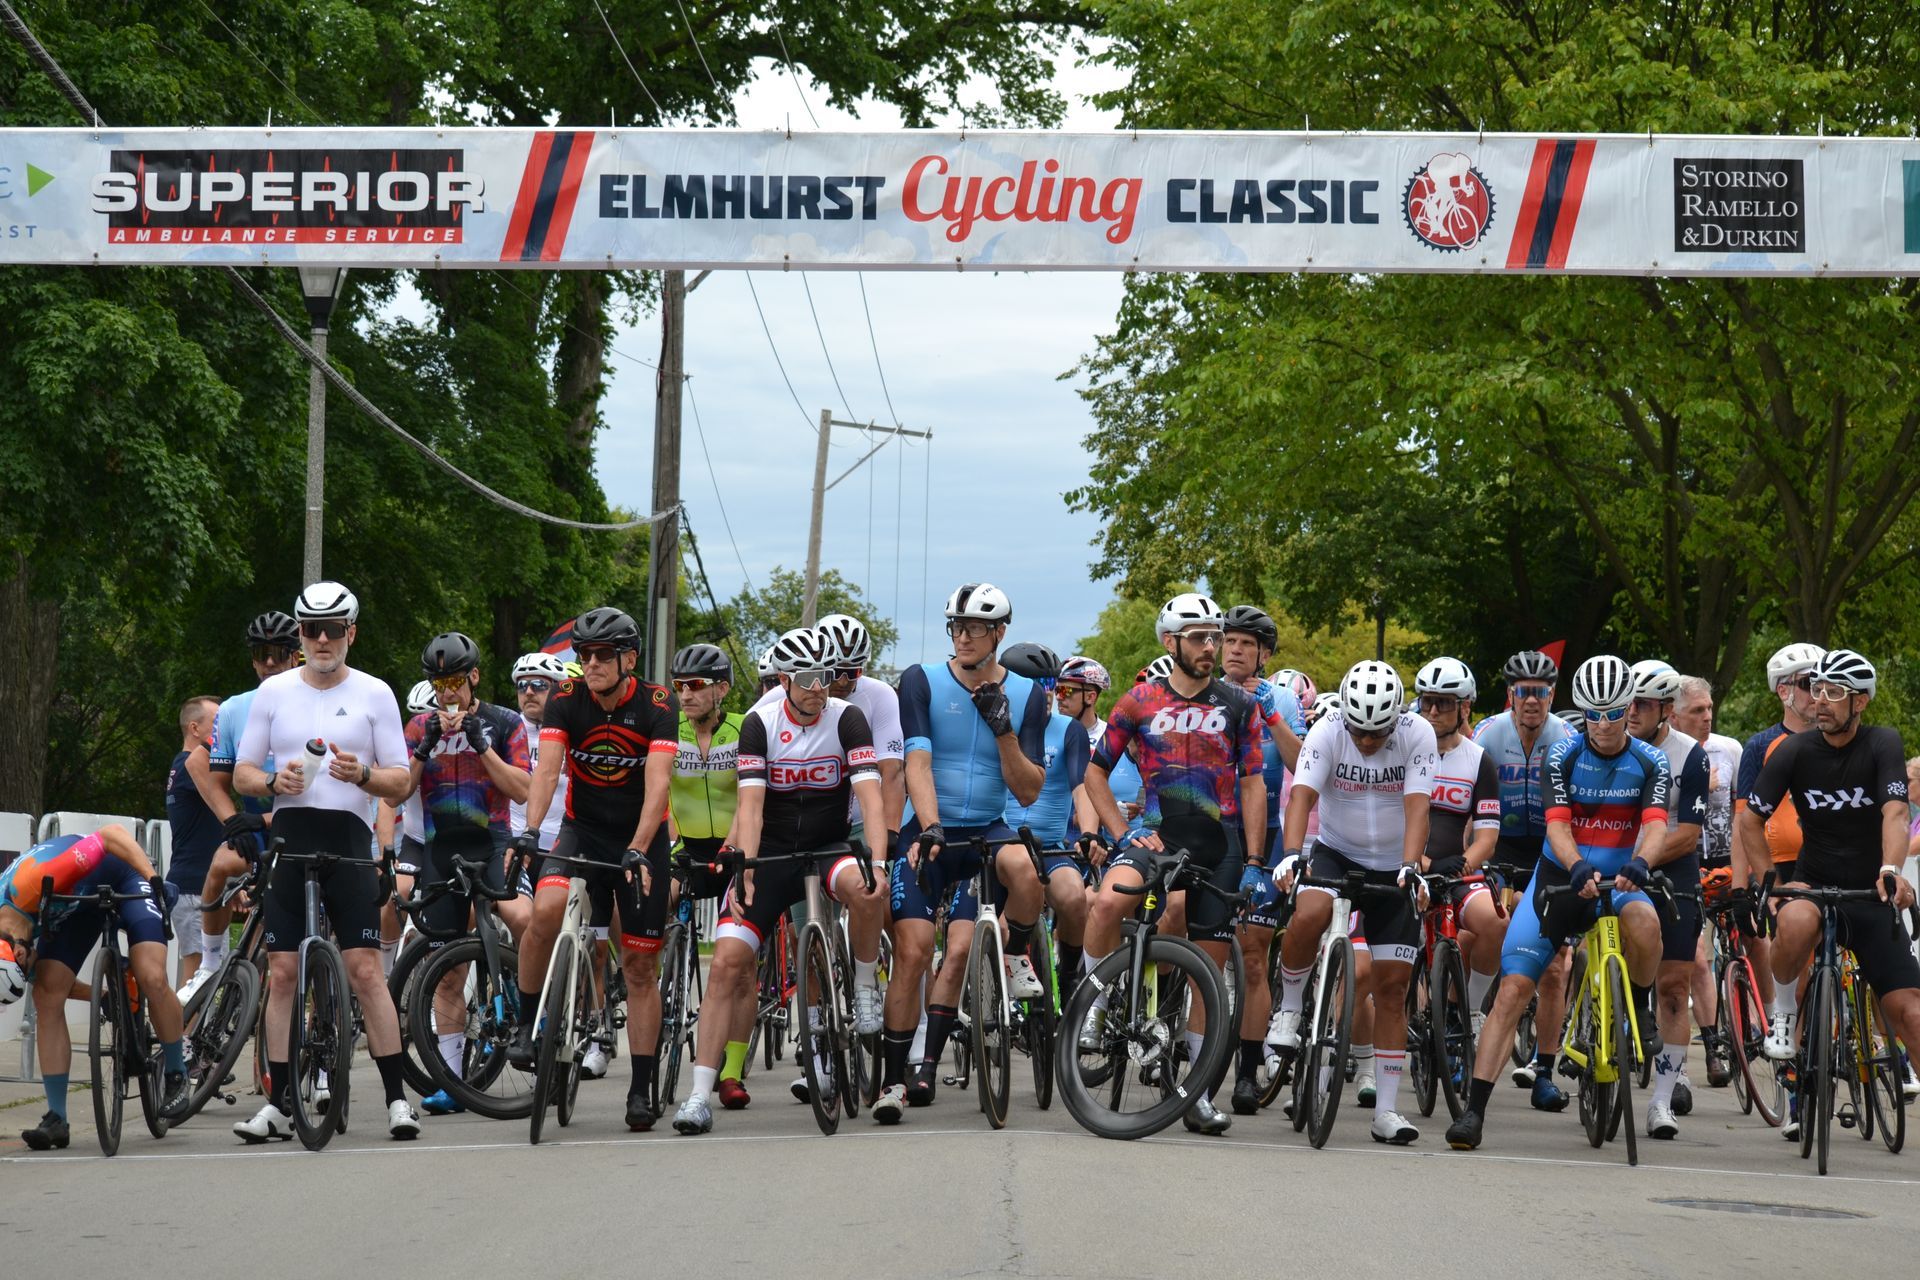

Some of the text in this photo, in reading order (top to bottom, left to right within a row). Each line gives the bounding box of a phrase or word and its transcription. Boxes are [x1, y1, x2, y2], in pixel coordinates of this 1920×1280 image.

[1682, 164, 1788, 188] STORINO
[92, 171, 485, 213] SUPERIOR
[600, 155, 1380, 245] ELMHURST Cycling CLASSIC
[1682, 194, 1799, 218] RAMELLO
[114, 228, 457, 243] AMBULANCE SERVICE
[1147, 706, 1227, 736] 606
[1336, 762, 1406, 784] CLEVELAND
[1549, 737, 1577, 805] FLATLANDIA
[1639, 741, 1670, 805] FLATLANDIA
[1599, 788, 1641, 798] STANDARD
[1606, 919, 1616, 949] BMC
[1394, 946, 1415, 960] CCA
